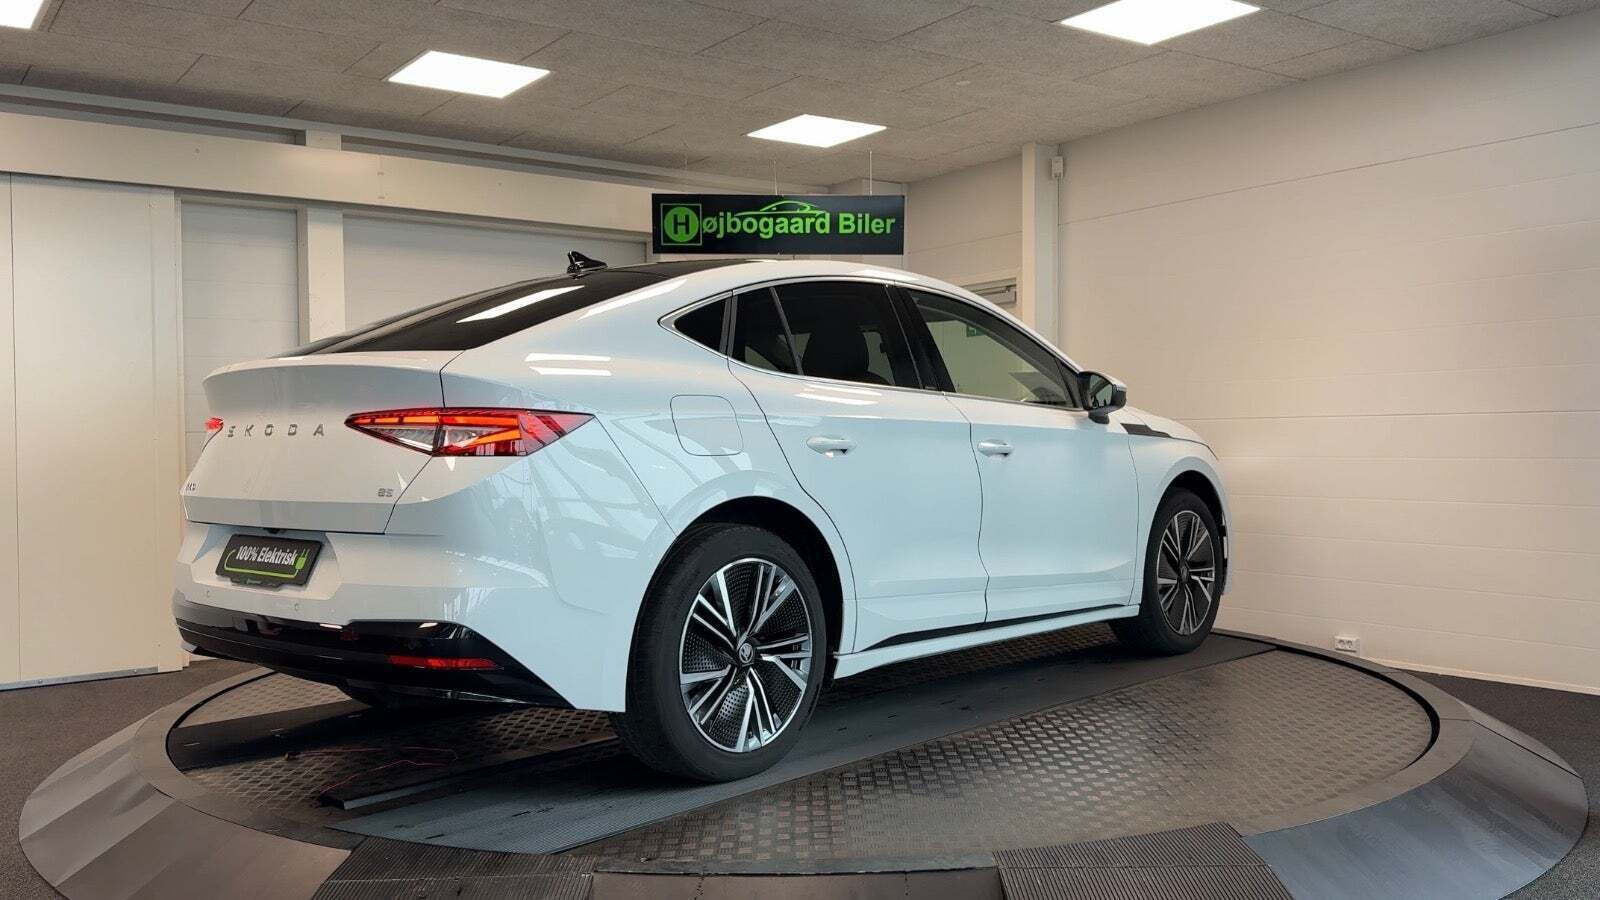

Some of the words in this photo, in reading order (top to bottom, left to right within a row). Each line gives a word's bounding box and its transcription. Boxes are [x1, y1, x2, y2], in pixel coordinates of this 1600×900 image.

[672, 212, 830, 239] Højbogaard
[839, 213, 896, 234] Biler
[236, 545, 259, 561] 100%
[257, 547, 298, 566] Elektrisk
